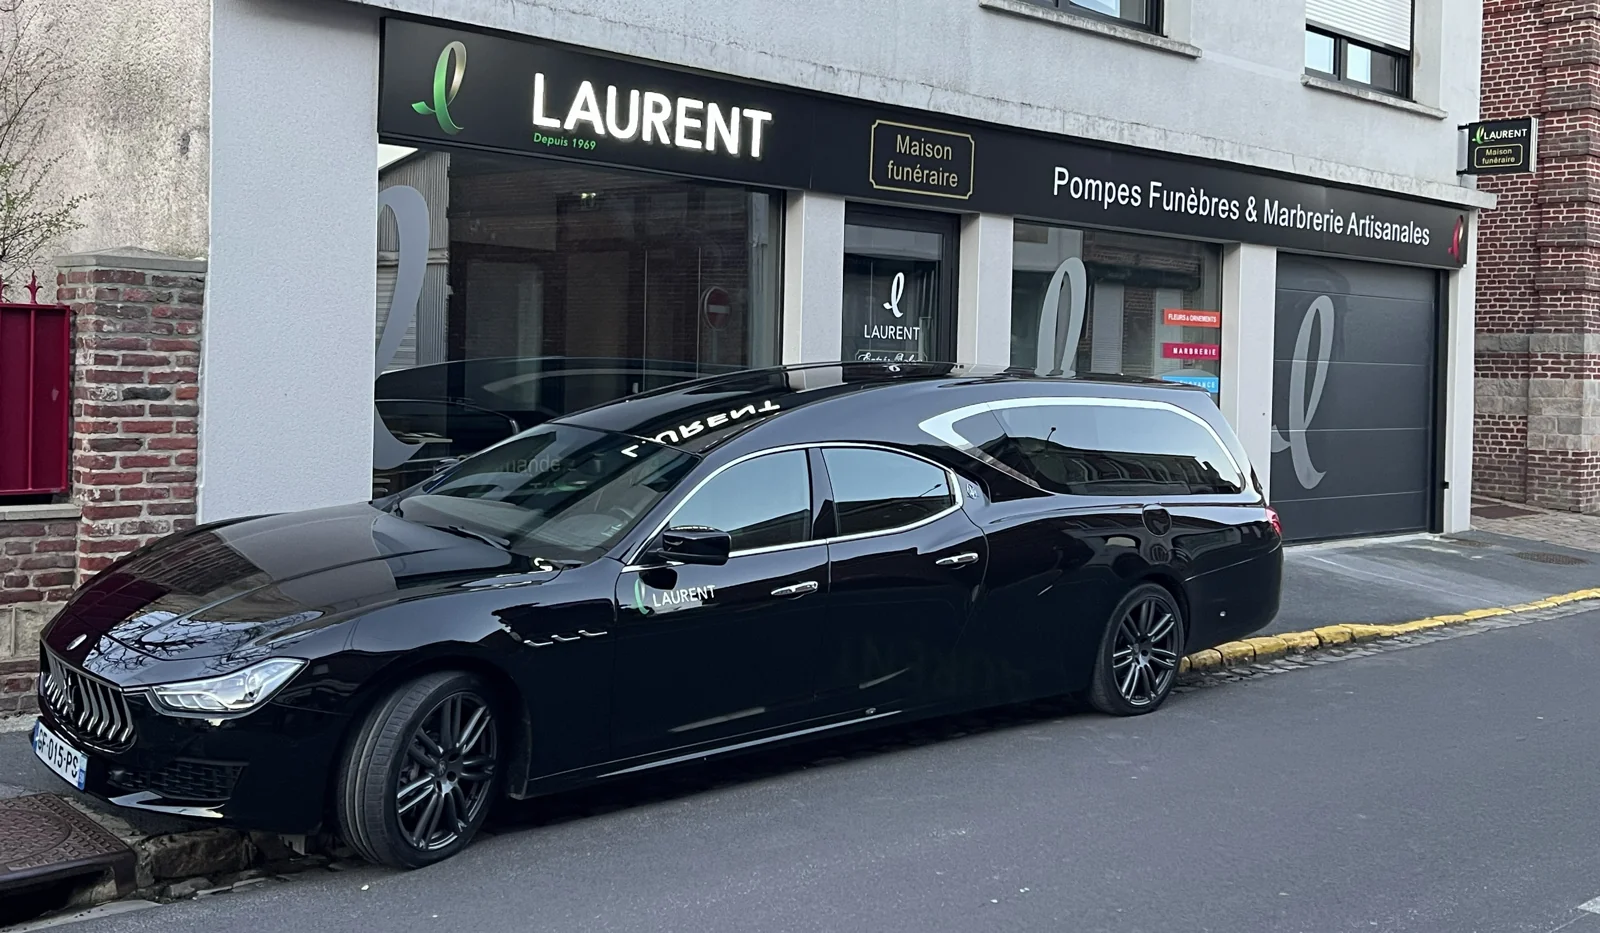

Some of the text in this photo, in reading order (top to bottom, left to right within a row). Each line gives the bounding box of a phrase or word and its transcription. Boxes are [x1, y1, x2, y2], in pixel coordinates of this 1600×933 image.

[532, 72, 772, 158] LAURENT
[533, 132, 597, 151] Depuis 1969
[1484, 129, 1528, 140] LAURENT
[896, 134, 952, 160] Maison
[1485, 148, 1513, 156] Maison
[1482, 156, 1516, 165] funéraire
[887, 160, 958, 187] funéraire
[1053, 166, 1430, 246] Pompes Funèbres & Marbrerie Artisanales
[1167, 313, 1186, 321] FLEURS
[864, 324, 920, 341] LAURENT
[1173, 347, 1216, 356] MARBRERIE
[652, 584, 716, 607] LAURENT
